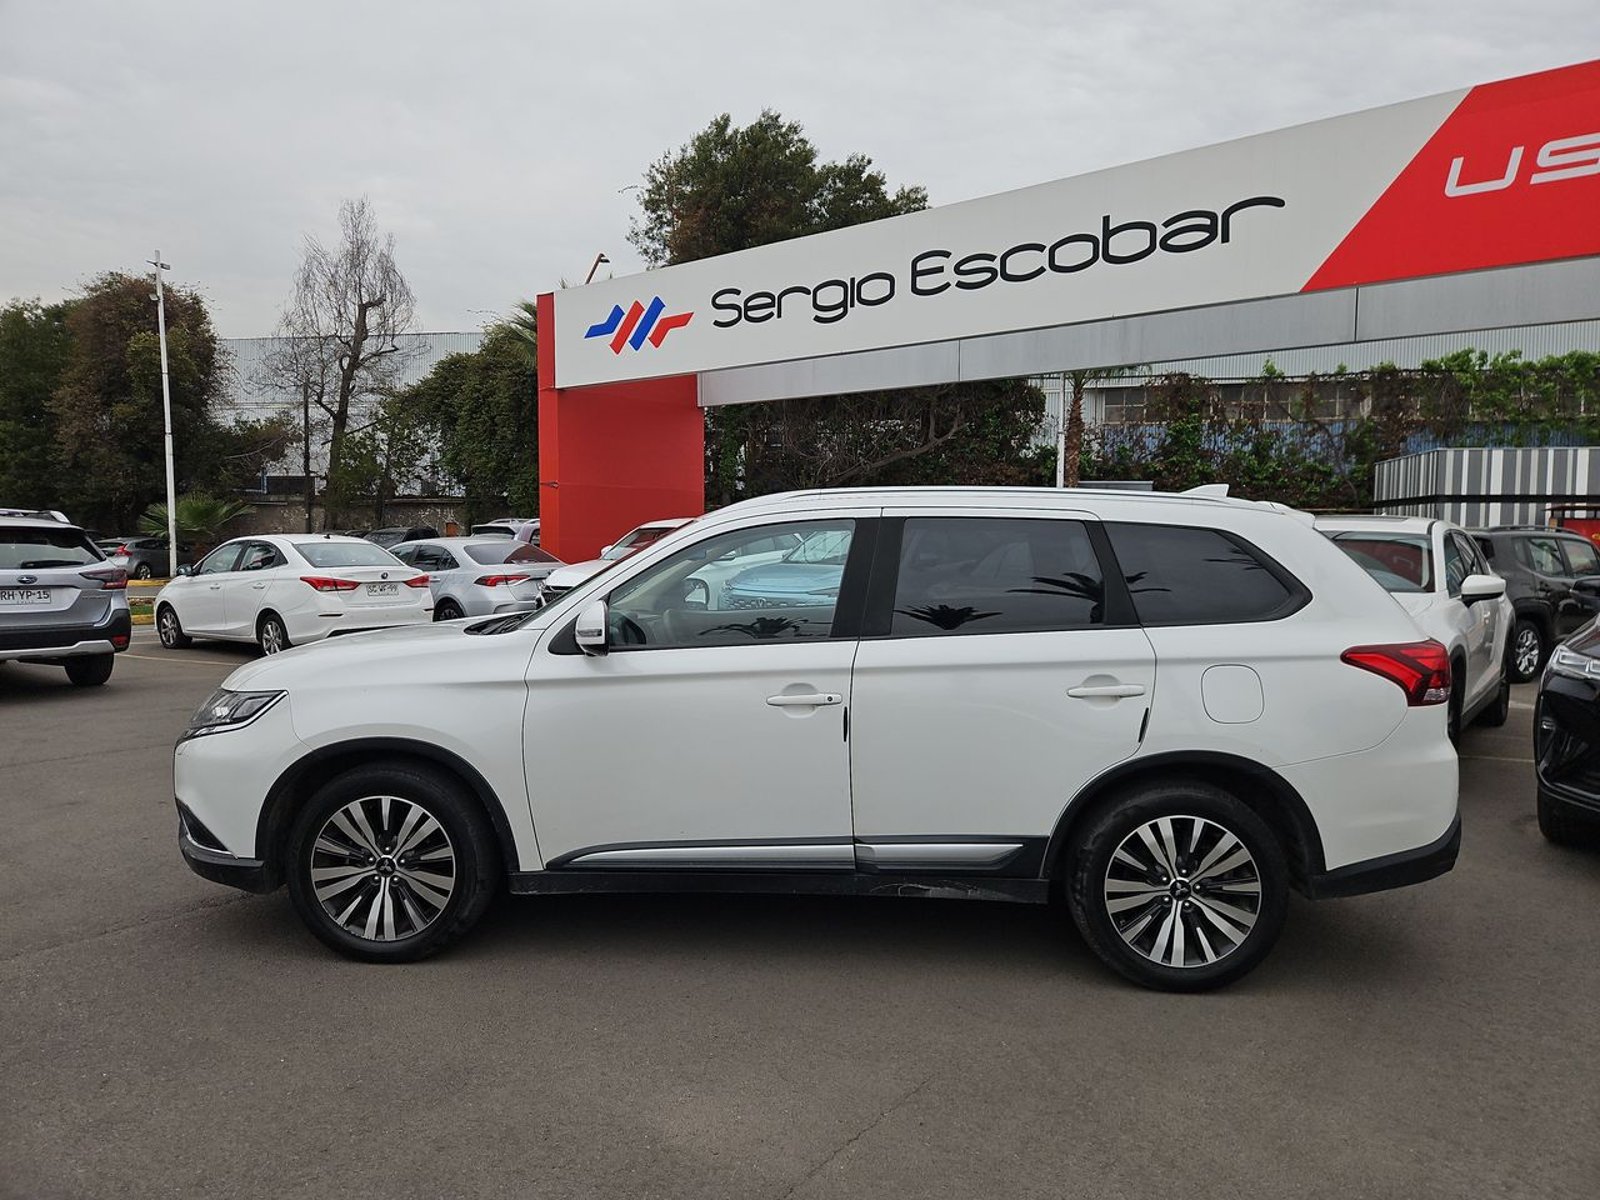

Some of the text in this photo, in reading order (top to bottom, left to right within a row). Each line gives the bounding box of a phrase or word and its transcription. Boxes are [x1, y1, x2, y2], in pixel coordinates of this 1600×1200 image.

[1444, 131, 1600, 198] US
[711, 196, 1286, 328] Sergio Escobar
